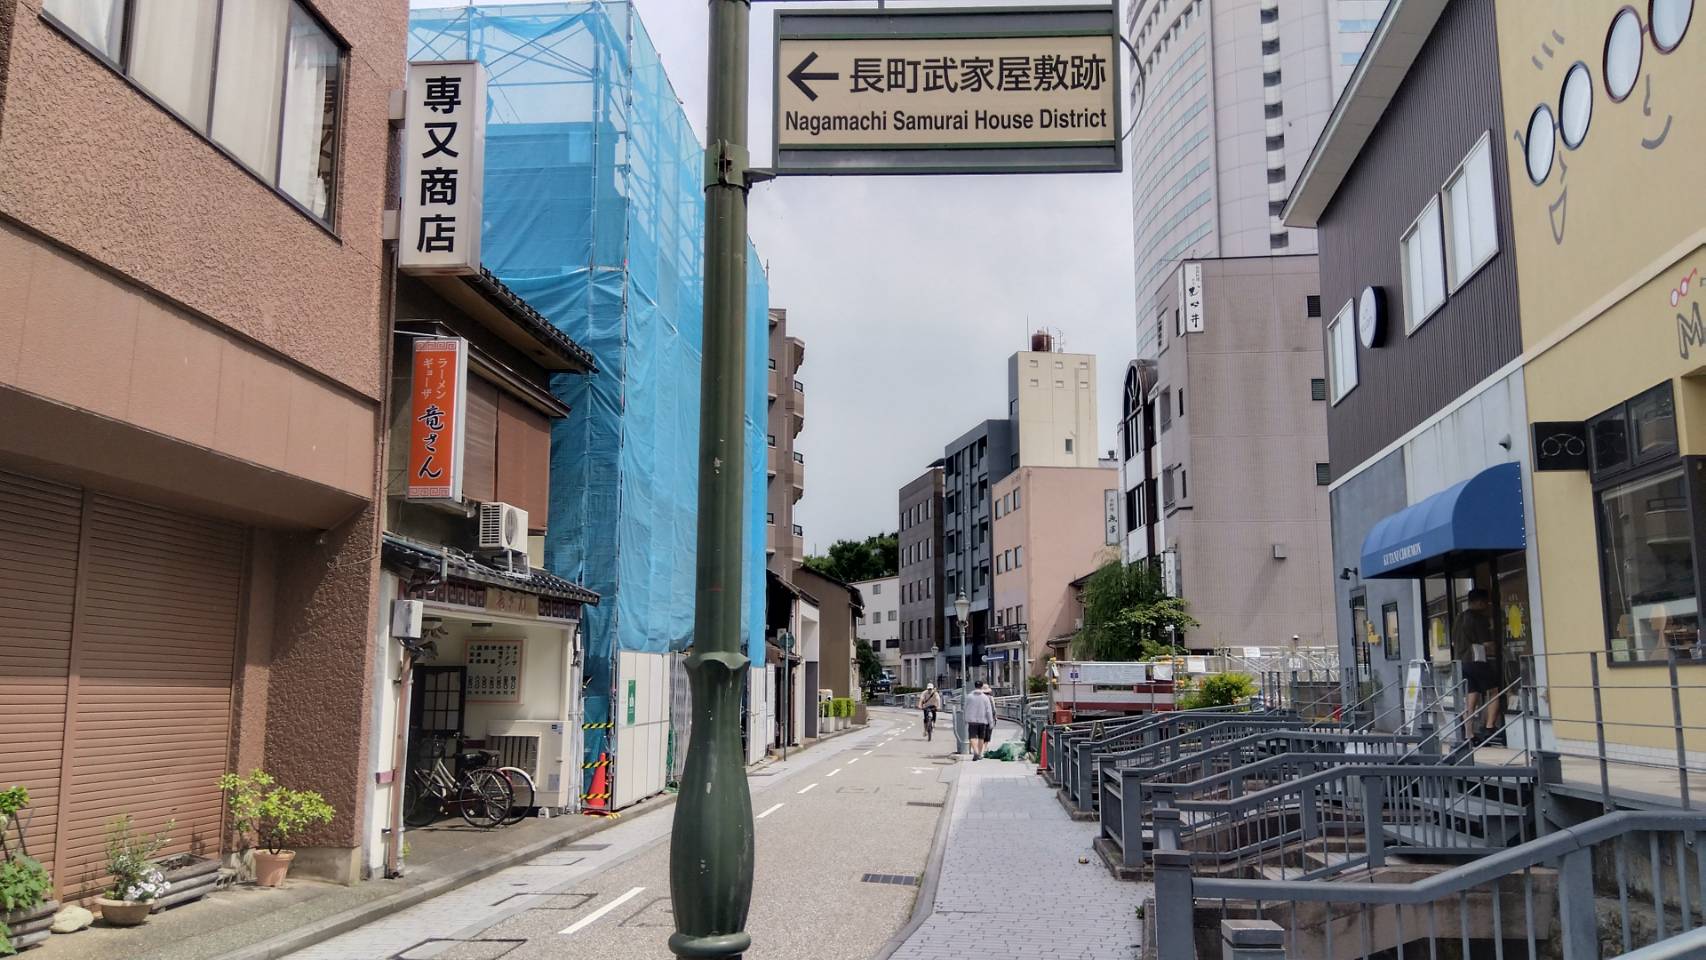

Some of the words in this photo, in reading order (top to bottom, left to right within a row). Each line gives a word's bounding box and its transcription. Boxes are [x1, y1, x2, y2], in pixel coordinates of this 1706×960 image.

[849, 53, 1107, 94] 長町武家屋敷跡
[785, 110, 887, 136] Nagamachi
[893, 109, 968, 131] Samurai
[975, 108, 1034, 130] House
[1039, 107, 1107, 129] District
[416, 75, 462, 253] 専又商店
[420, 358, 434, 400] ギョーザ
[436, 358, 448, 400] ラーメン
[417, 404, 444, 479] 竜さん
